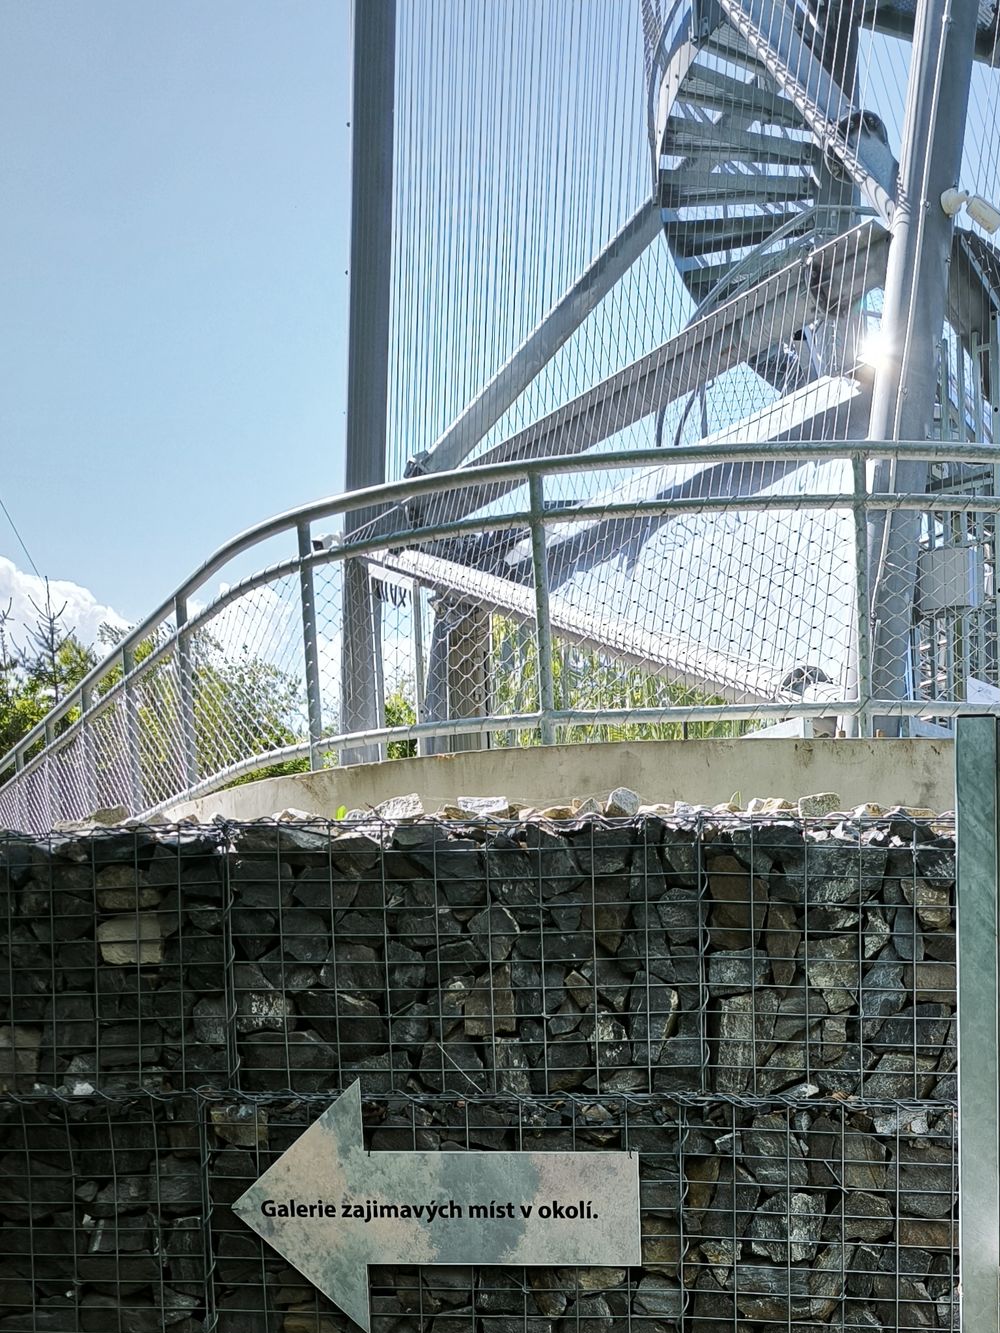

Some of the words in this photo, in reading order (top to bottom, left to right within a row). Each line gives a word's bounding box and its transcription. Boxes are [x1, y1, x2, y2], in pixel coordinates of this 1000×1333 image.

[261, 1199, 337, 1219] Galerie
[341, 1200, 462, 1222] zajimavých
[468, 1200, 515, 1219] míst
[520, 1205, 533, 1219] v
[538, 1200, 599, 1220] okolí.
